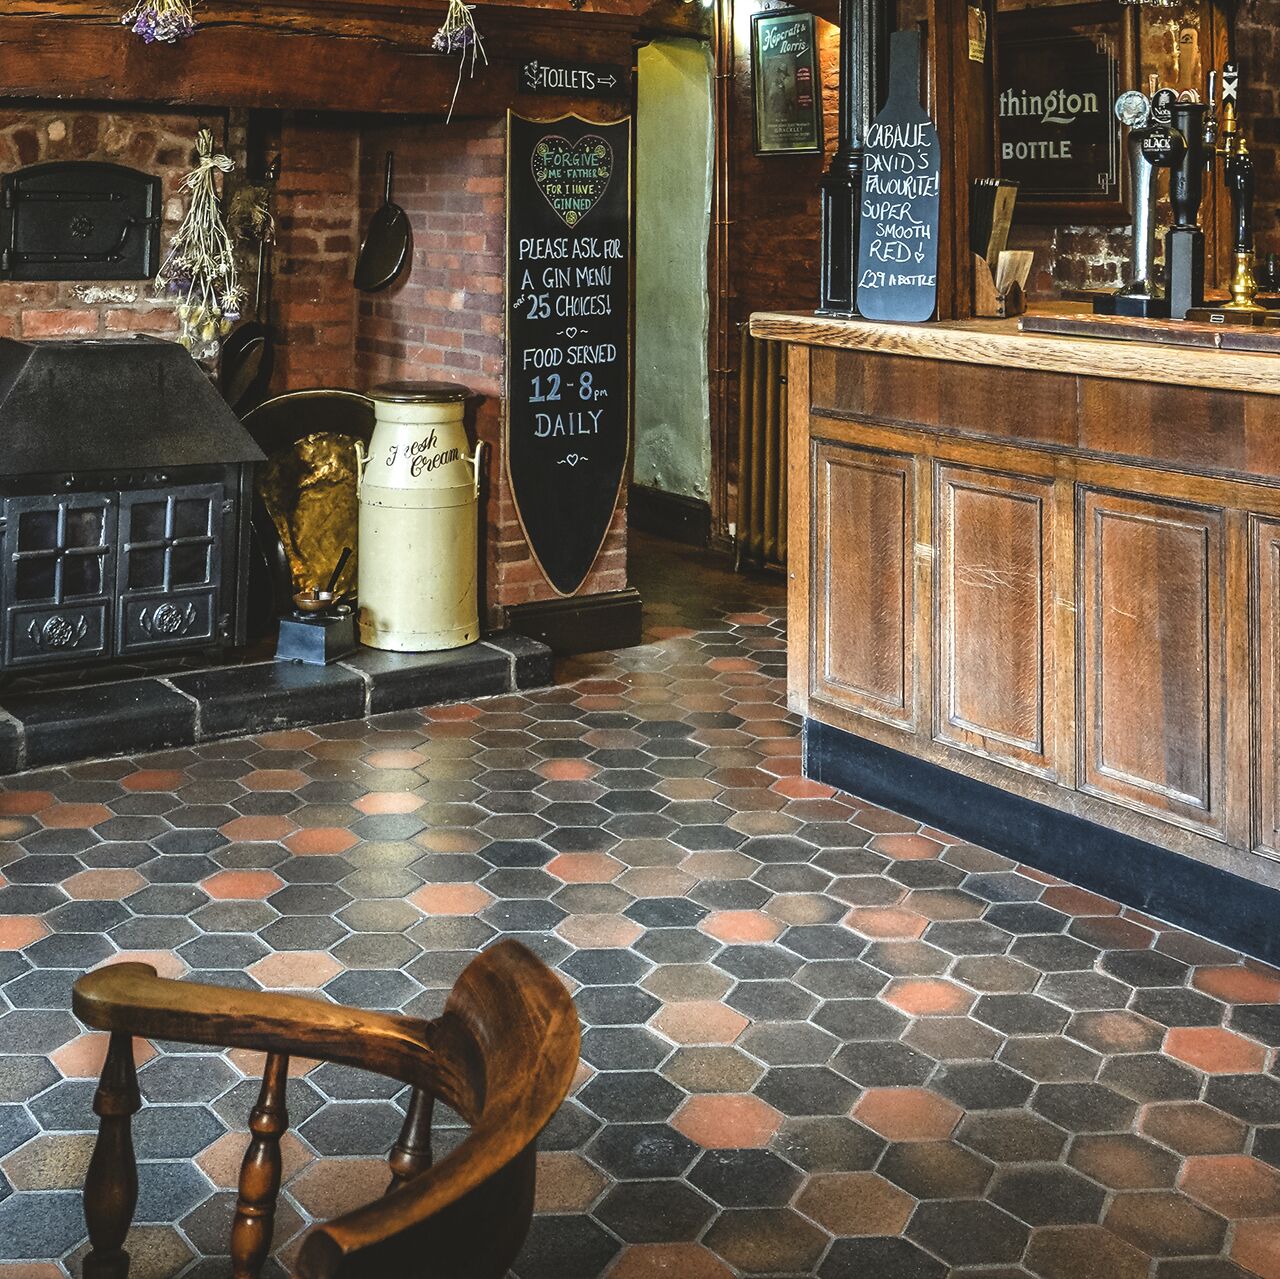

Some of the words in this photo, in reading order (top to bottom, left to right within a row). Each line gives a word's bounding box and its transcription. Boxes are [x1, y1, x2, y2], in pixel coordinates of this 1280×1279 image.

[762, 23, 800, 51] Hopcraft
[780, 40, 807, 54] Norris
[540, 66, 596, 89] TOILETS
[1002, 141, 1072, 160] BOTTLE
[1143, 138, 1171, 148] BLACK
[543, 151, 599, 166] FORGIVE
[864, 149, 929, 174] DAVID'S
[566, 168, 597, 179] FATHER
[546, 184, 563, 195] FOR
[565, 184, 570, 195] I
[572, 184, 594, 195] HAVE
[865, 171, 939, 199] FAVOURITE!
[553, 198, 592, 210] GINNED
[862, 200, 923, 224] SUPER
[876, 223, 930, 239] SMOOTH
[519, 238, 569, 260] PLEASE
[572, 238, 601, 259] ASK
[603, 239, 623, 259] FOR
[521, 269, 534, 291] A
[542, 267, 570, 288] GIN
[576, 266, 611, 288] MENU
[858, 269, 885, 288] £29
[898, 274, 936, 286] BOTTLE
[526, 294, 551, 319] 25
[555, 294, 612, 317] CHOICES!
[523, 348, 563, 370] FOOD
[567, 344, 616, 365] SERVED
[534, 410, 604, 438] DAILY
[410, 448, 459, 477] Cream
